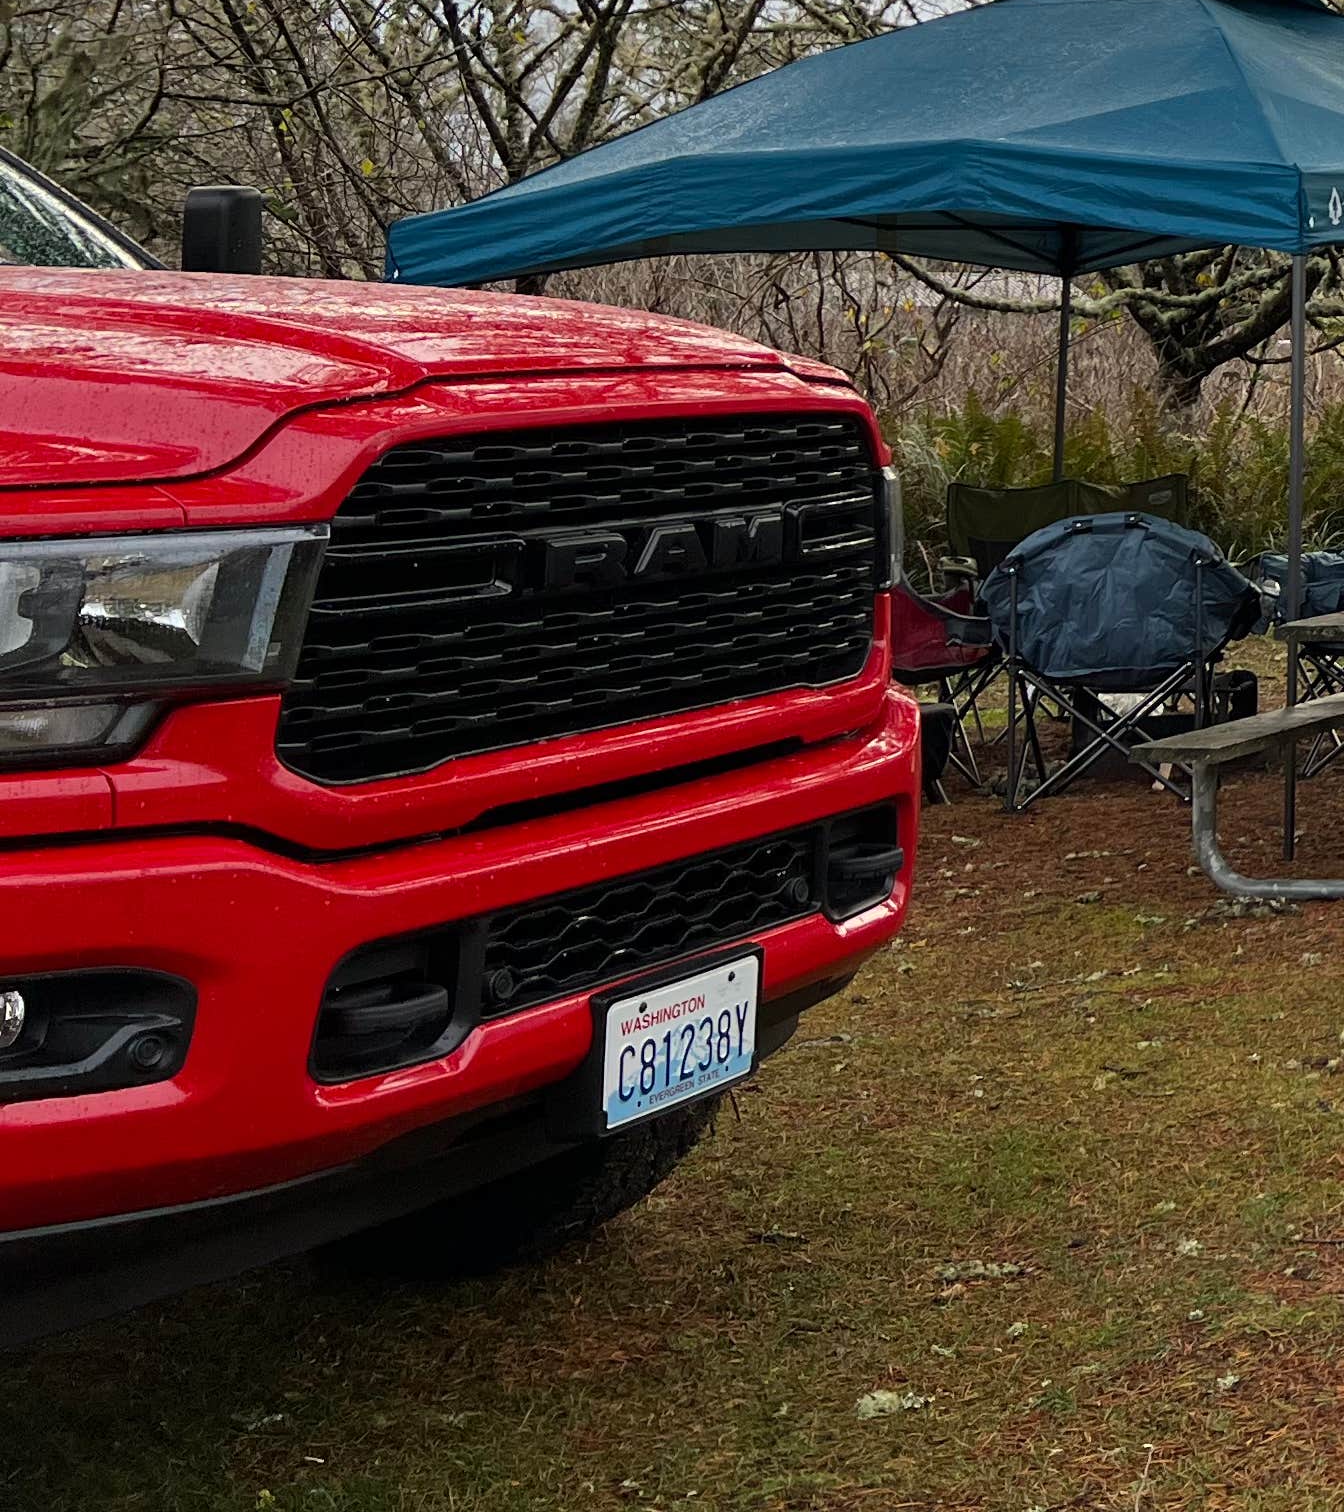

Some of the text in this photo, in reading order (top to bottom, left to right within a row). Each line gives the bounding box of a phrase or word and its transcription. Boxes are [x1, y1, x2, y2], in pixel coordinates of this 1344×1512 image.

[546, 513, 783, 587] RAM
[620, 993, 706, 1037] WASHINGTON
[618, 1000, 749, 1103] C81238Y
[648, 1068, 720, 1105] EVERGREEN STATE
